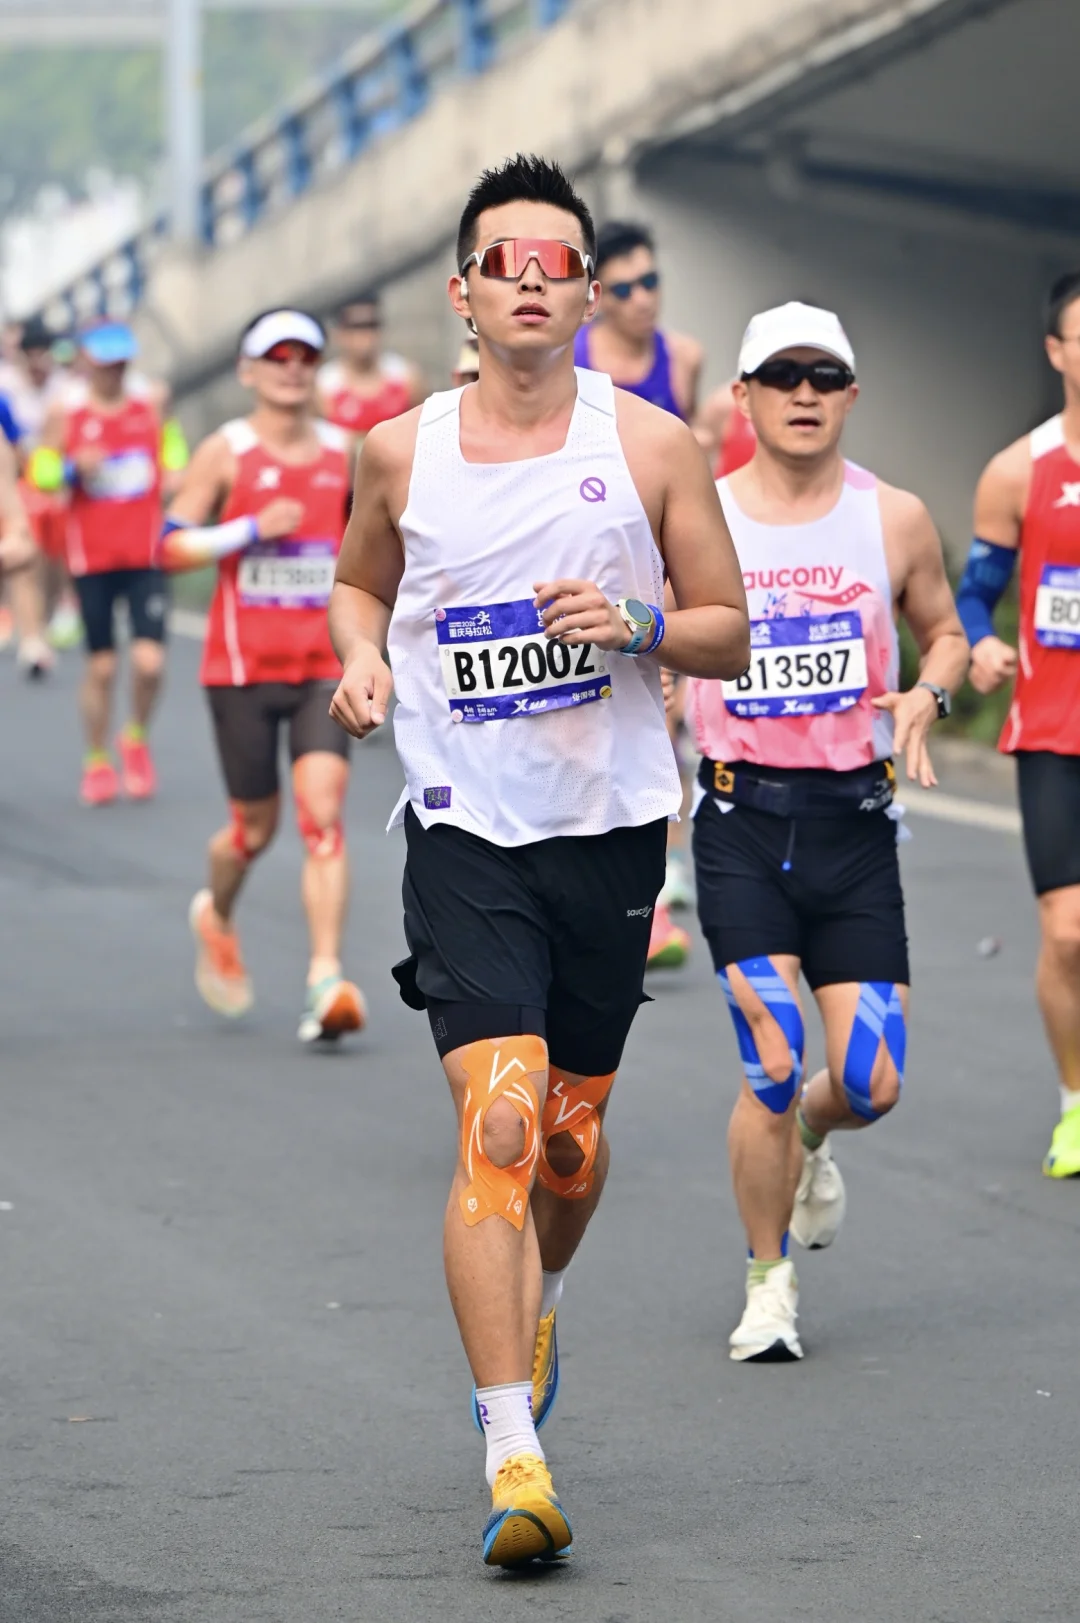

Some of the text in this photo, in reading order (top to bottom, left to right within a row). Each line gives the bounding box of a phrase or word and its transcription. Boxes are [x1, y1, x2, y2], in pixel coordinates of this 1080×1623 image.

[743, 566, 844, 591] aucony
[449, 626, 493, 638] 重庆马拉松
[454, 638, 595, 692] B12002
